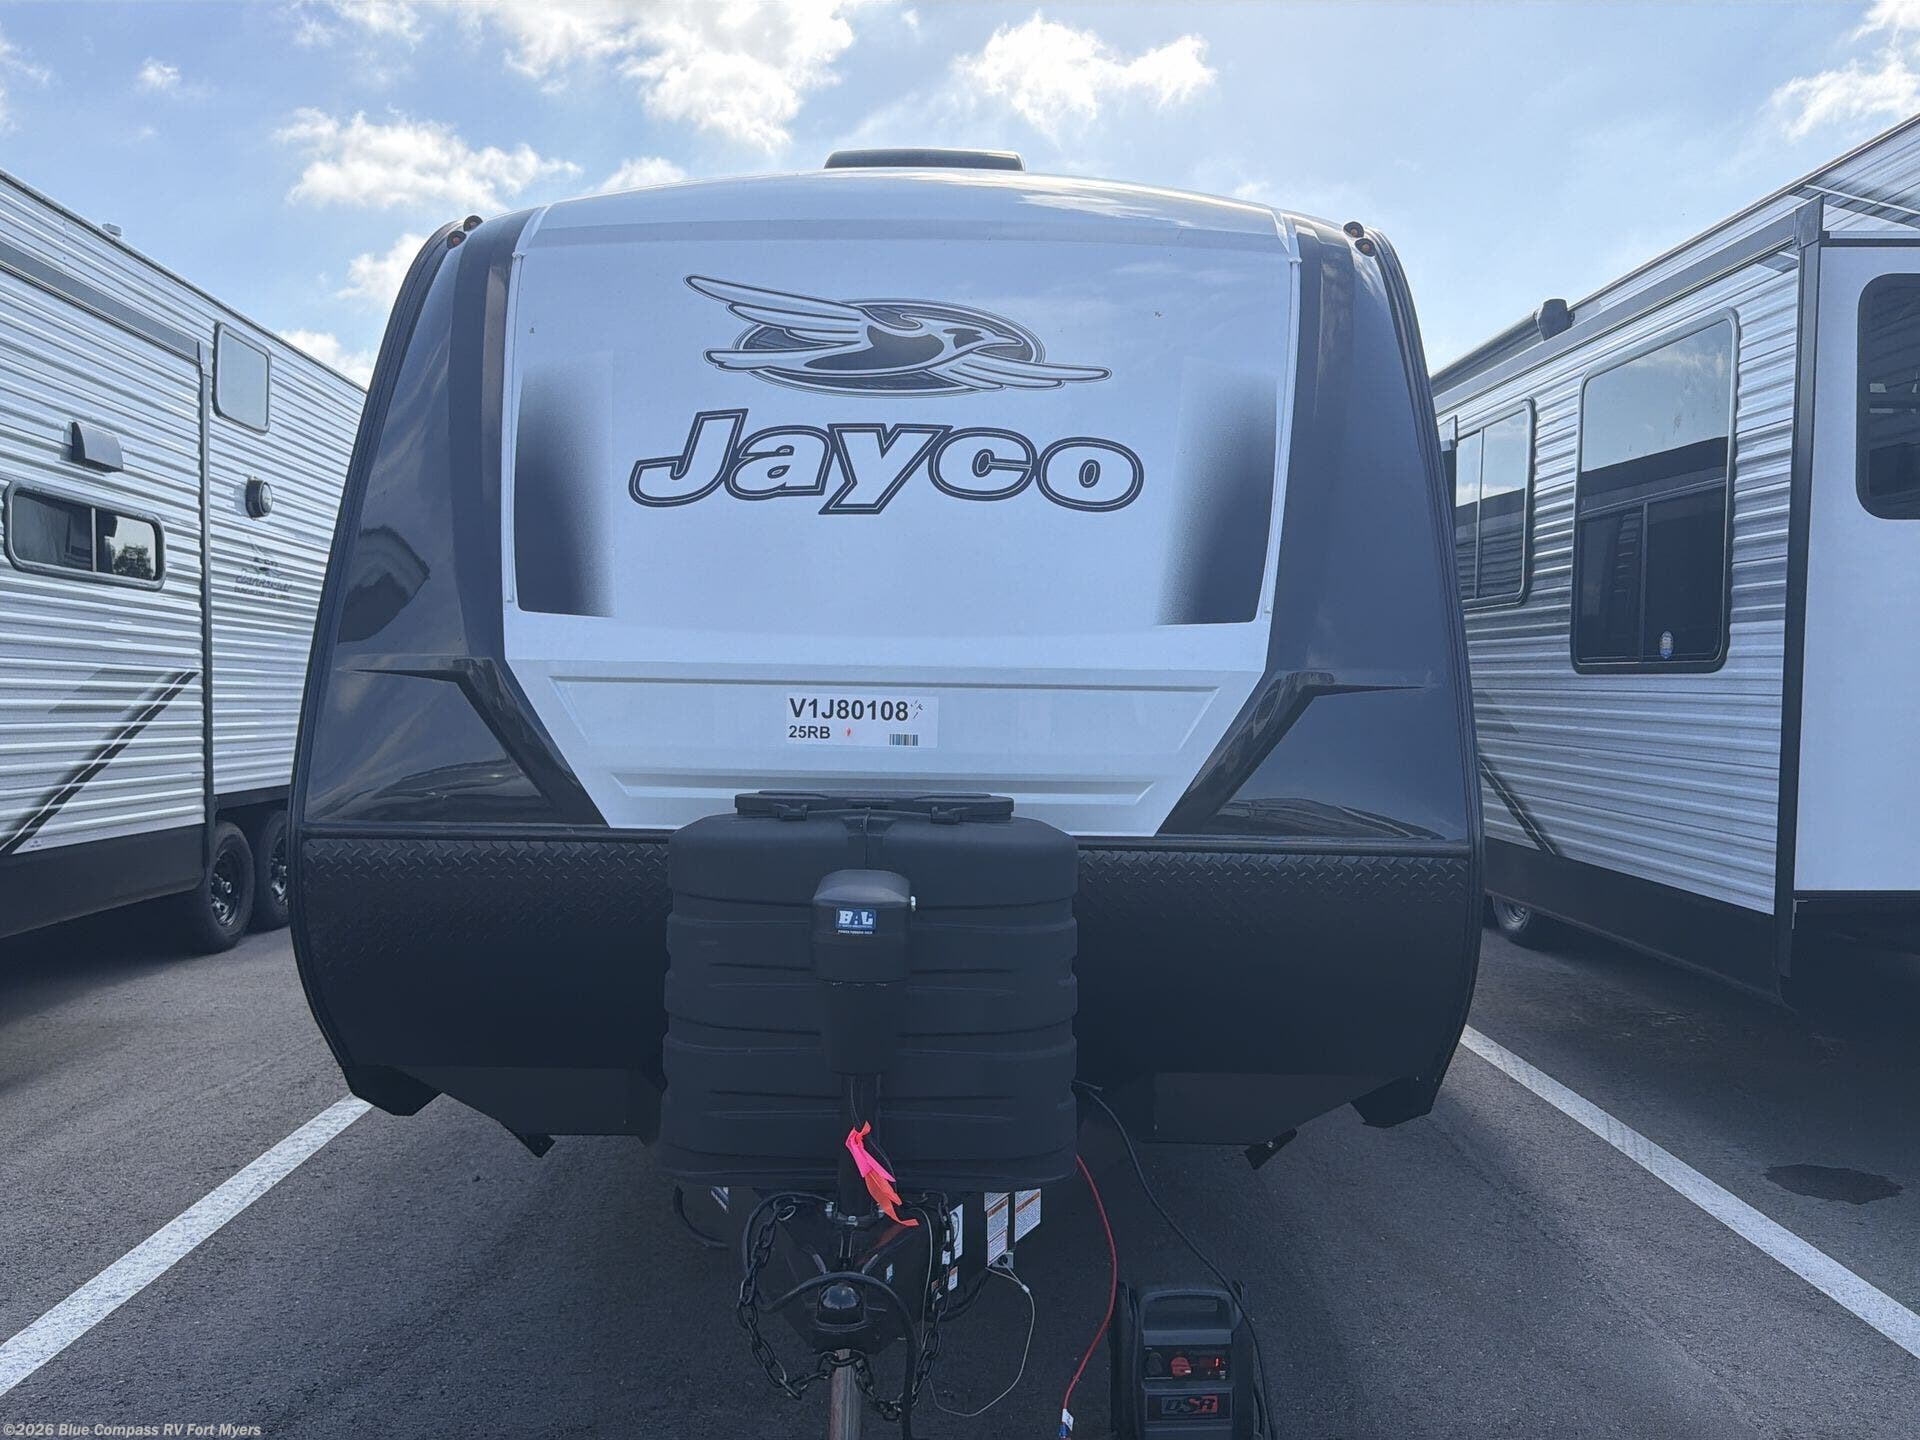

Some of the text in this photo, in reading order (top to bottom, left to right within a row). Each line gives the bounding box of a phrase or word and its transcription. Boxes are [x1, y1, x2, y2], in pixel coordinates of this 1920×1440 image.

[628, 408, 1144, 515] Jayco
[789, 698, 909, 721] V1J80108
[788, 725, 831, 739] 25RB
